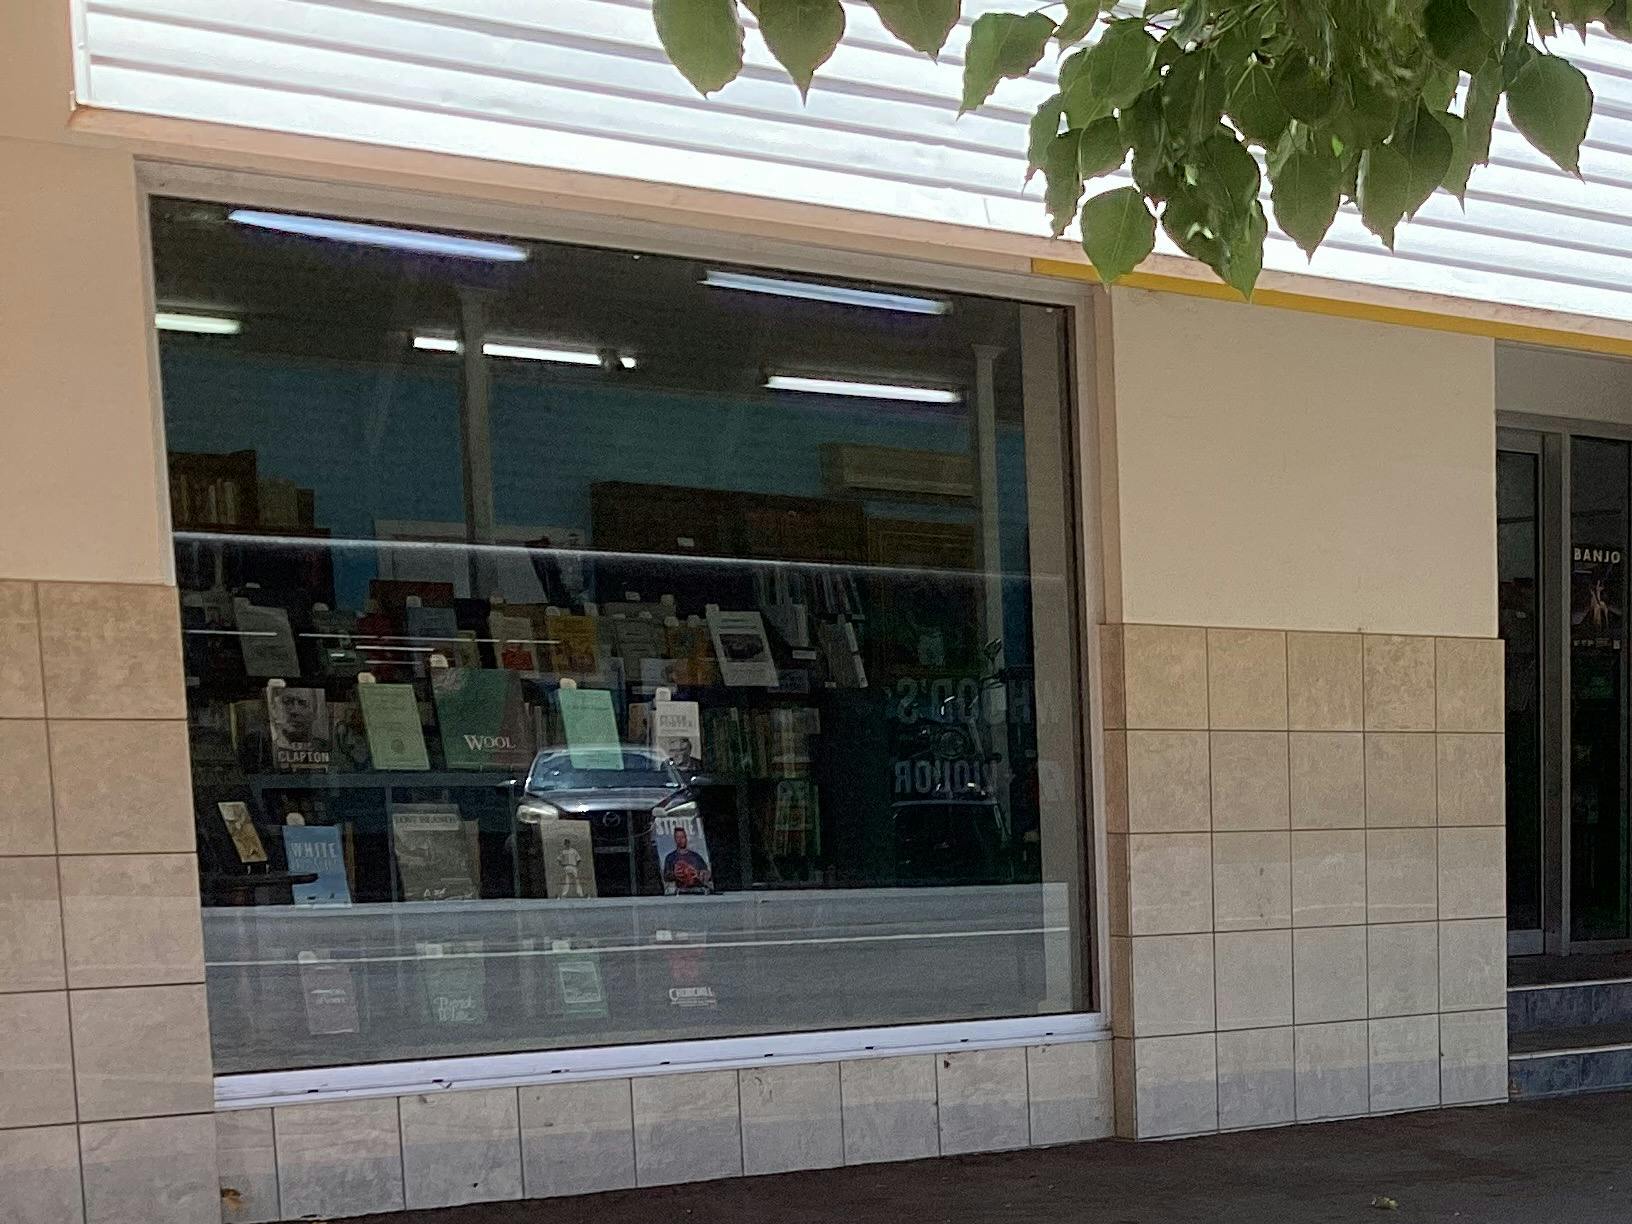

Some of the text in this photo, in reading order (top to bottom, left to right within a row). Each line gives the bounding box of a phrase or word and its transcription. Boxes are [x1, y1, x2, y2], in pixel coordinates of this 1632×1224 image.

[1573, 547, 1621, 564] BANJO
[463, 734, 517, 751] WOOL
[278, 751, 330, 763] CLAPTON
[290, 842, 338, 859] WHITE
